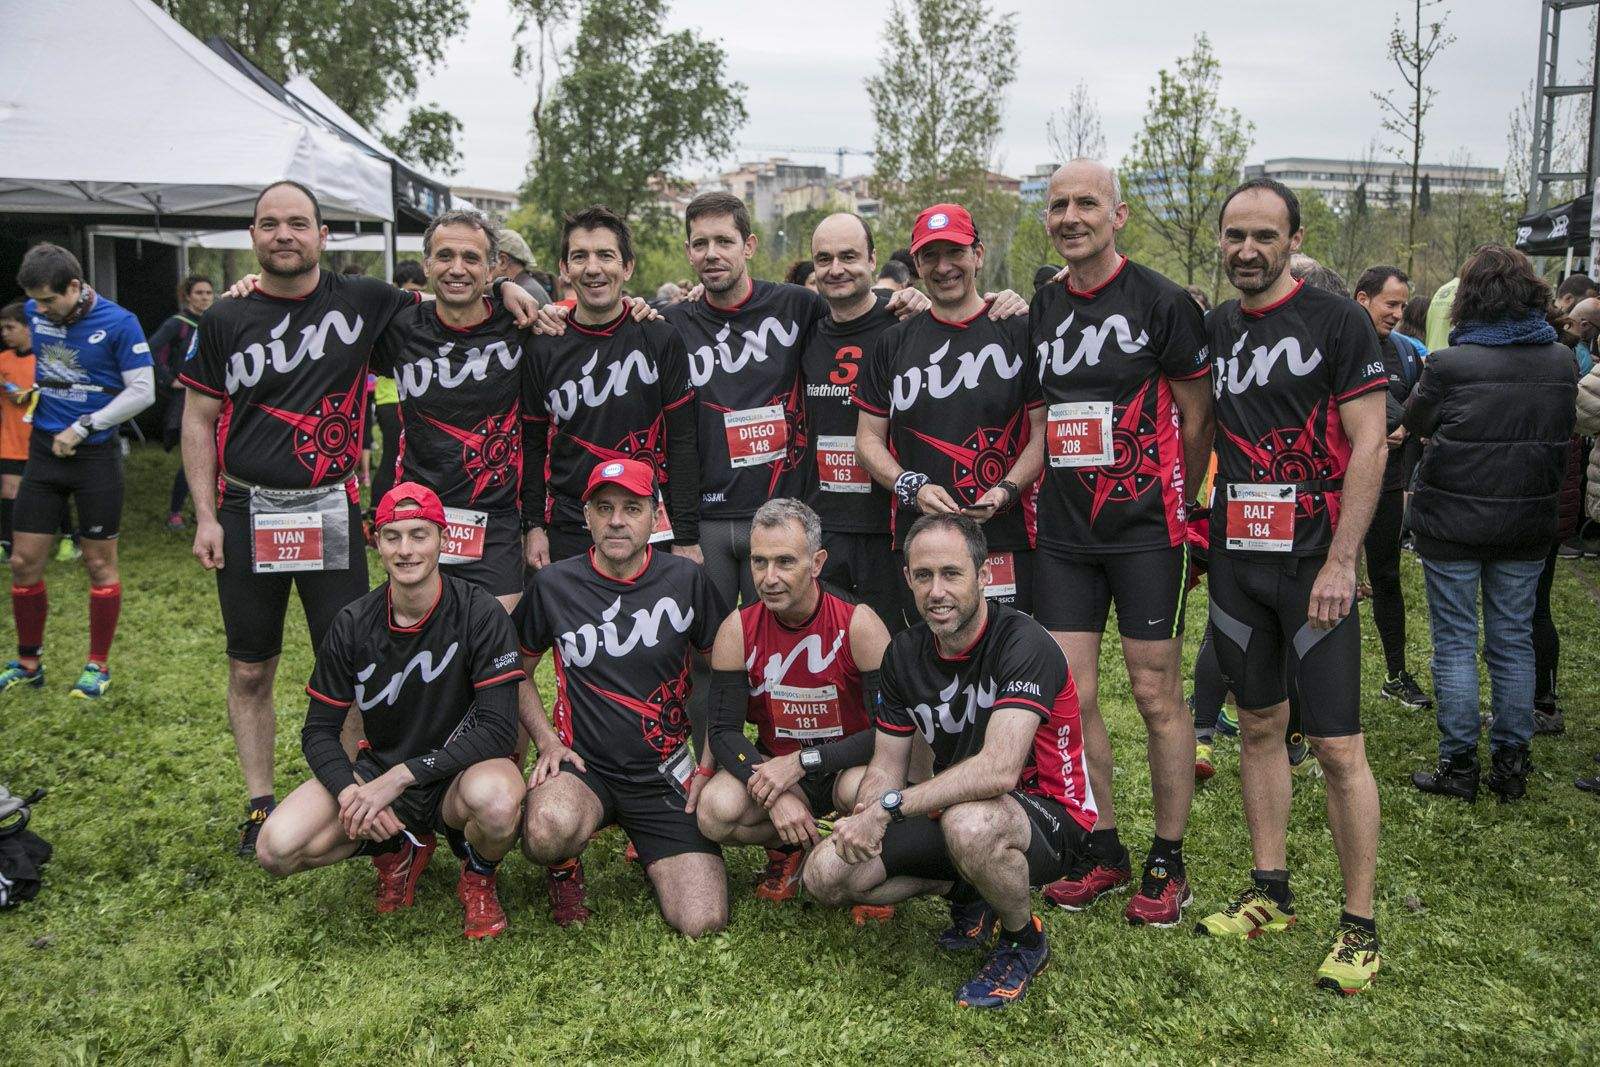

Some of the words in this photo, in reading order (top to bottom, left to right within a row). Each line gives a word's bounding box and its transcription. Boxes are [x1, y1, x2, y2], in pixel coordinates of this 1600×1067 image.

[739, 424, 775, 440] DIEGO
[1057, 422, 1089, 437] MANE
[749, 440, 770, 453] 148
[1062, 440, 1081, 454] 208
[833, 469, 851, 481] 163
[1243, 505, 1275, 519] RALF
[1247, 523, 1270, 537] 184
[273, 531, 305, 544] IVAN
[278, 547, 300, 560] 227
[1006, 681, 1042, 697] AS&NL
[782, 702, 829, 715] XAVIER
[795, 717, 818, 729] 181
